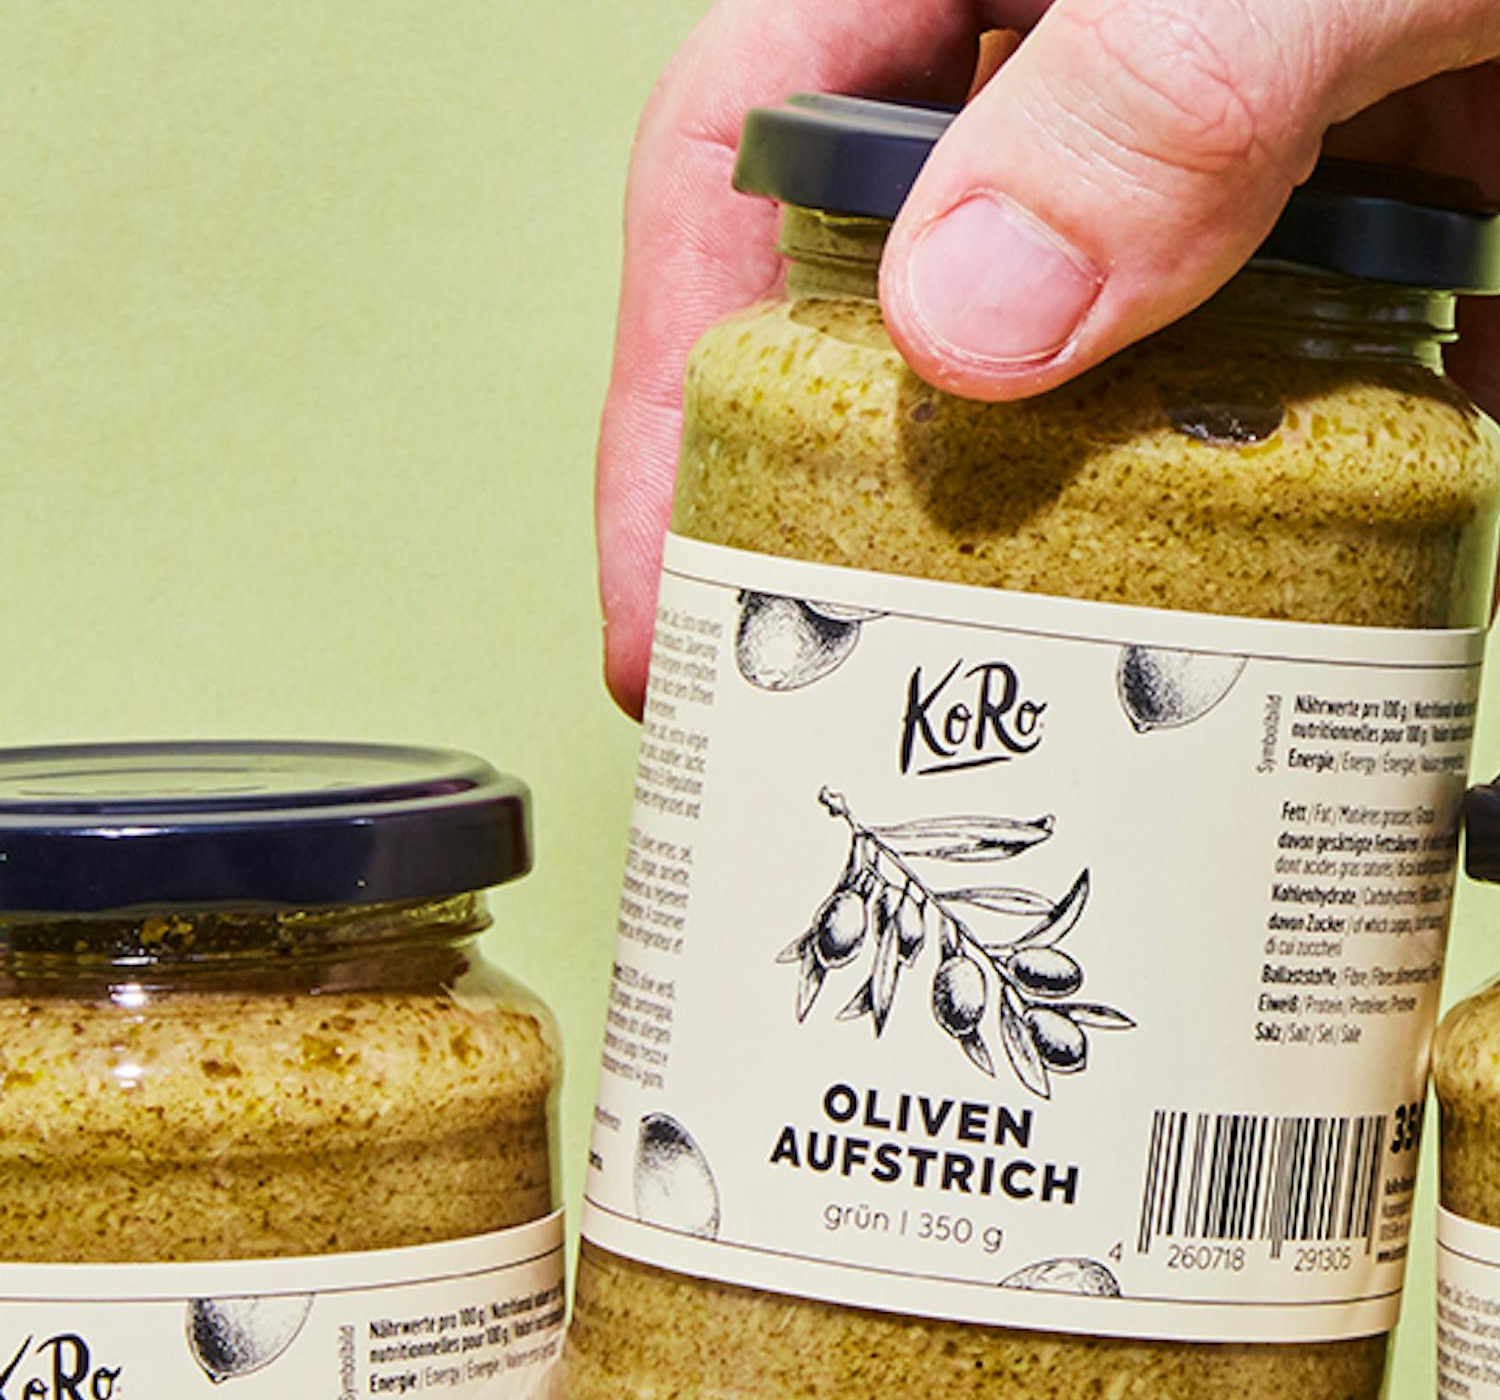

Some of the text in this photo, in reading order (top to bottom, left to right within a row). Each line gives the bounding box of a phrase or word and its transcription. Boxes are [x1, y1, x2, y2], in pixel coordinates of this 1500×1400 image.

[900, 658, 1047, 775] KoRo
[1295, 696, 1358, 717] Nährwerte
[1257, 695, 1282, 774] Symbolbild
[1288, 747, 1335, 772] Energie
[1282, 801, 1306, 821] Fett
[1278, 832, 1314, 849] davon
[1272, 884, 1356, 907] Kohlenhydrate
[1268, 913, 1345, 932] davon Zucker
[1262, 963, 1336, 984] Ballaststoffe
[1255, 1022, 1281, 1041] Salz
[823, 1083, 1033, 1148] OLIVEN
[769, 1125, 1079, 1205] AUFSTRICH
[823, 1203, 1003, 1253] grün 350 g
[1109, 1241, 1353, 1272] 4 260718 291305
[369, 1370, 417, 1394] Energie
